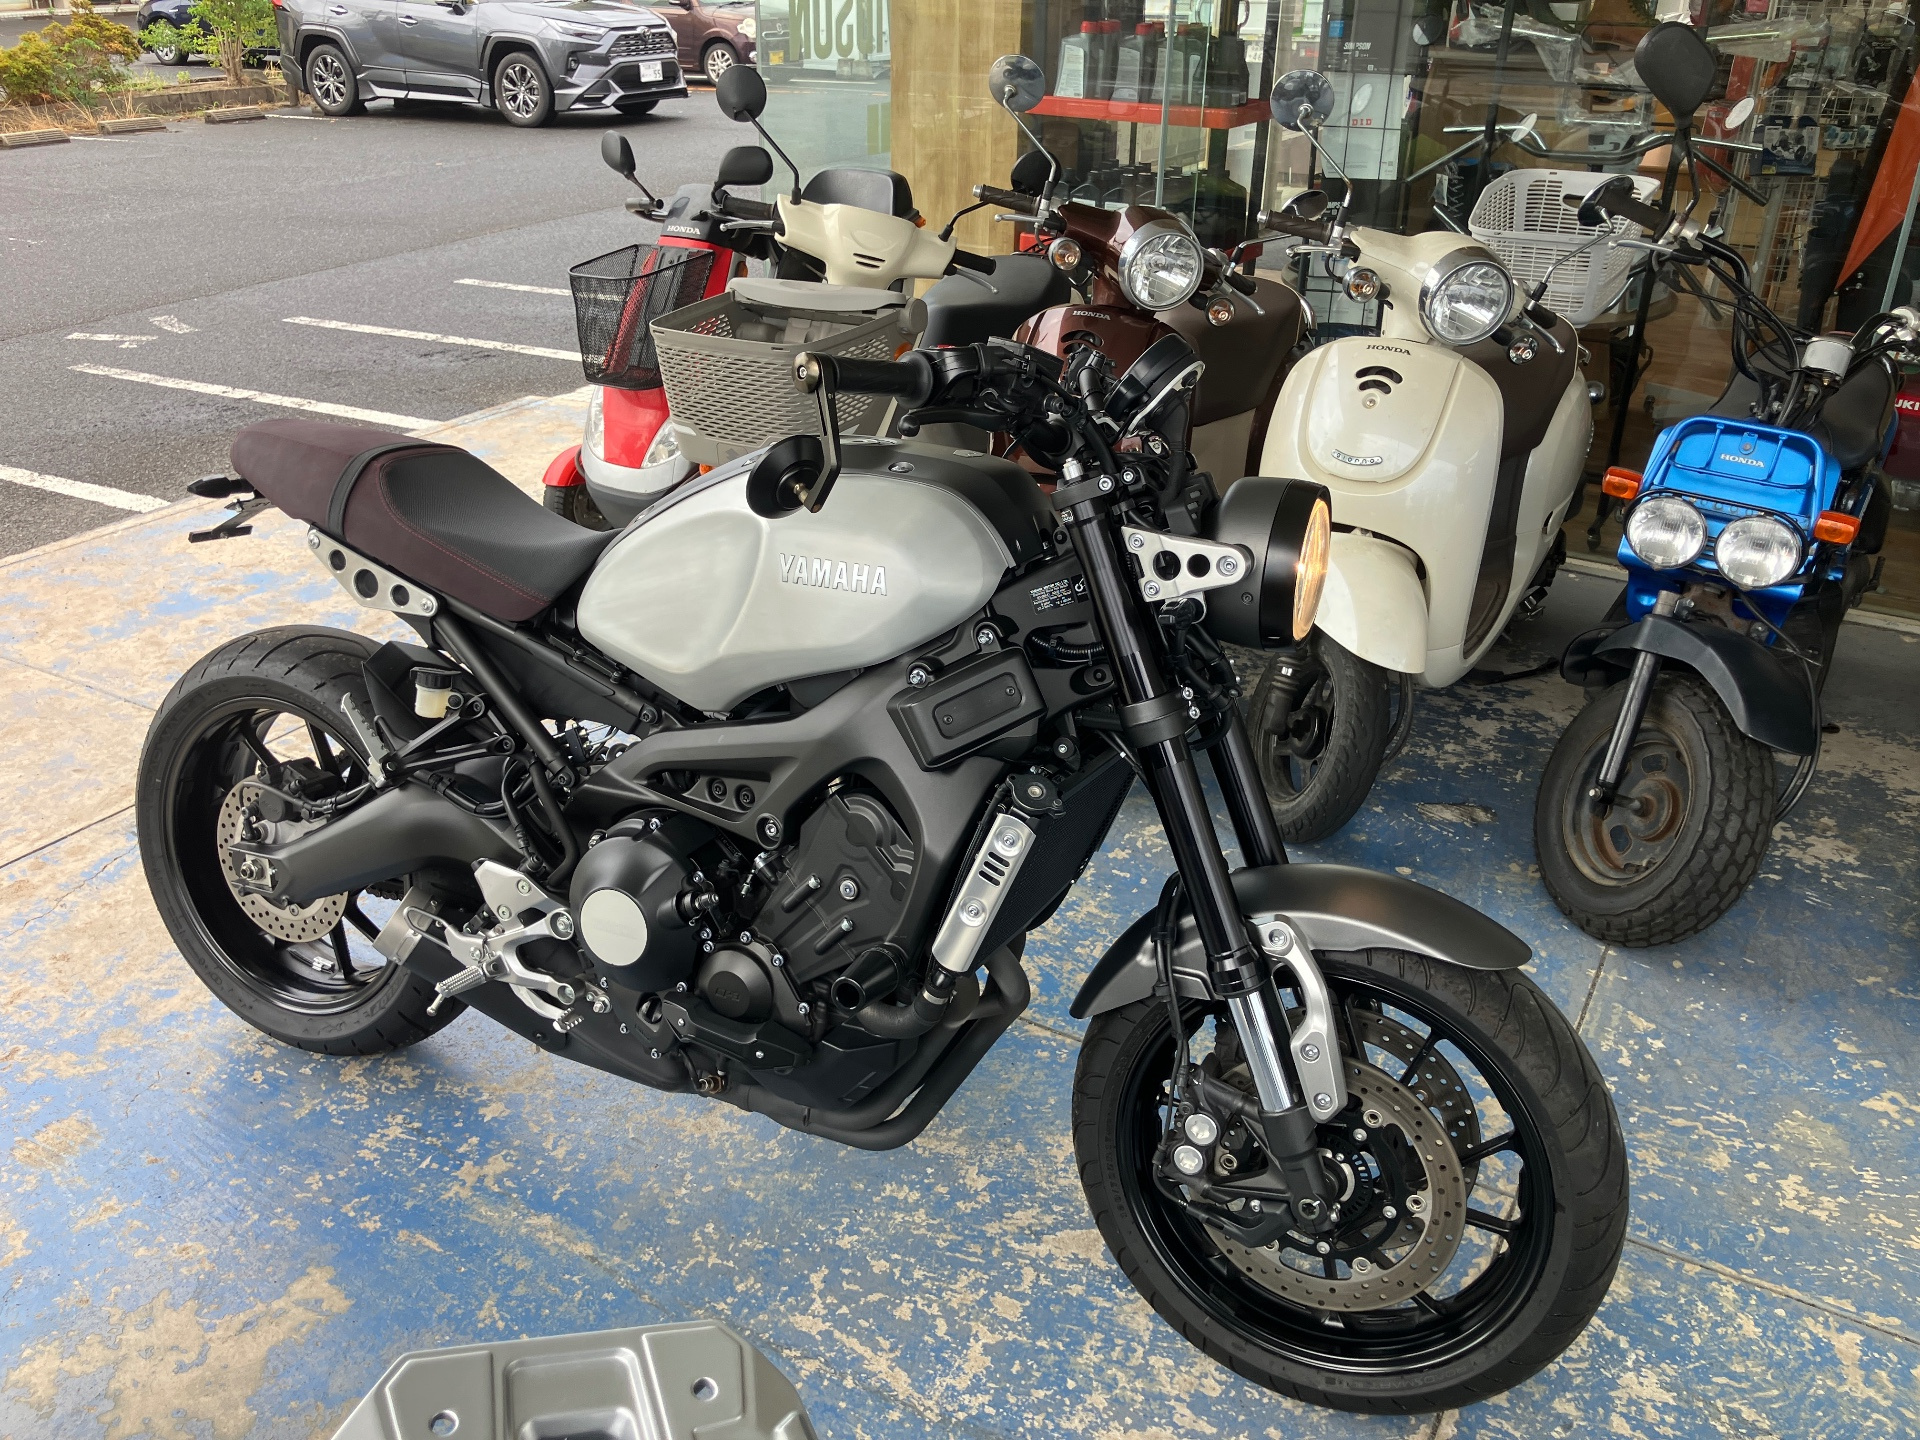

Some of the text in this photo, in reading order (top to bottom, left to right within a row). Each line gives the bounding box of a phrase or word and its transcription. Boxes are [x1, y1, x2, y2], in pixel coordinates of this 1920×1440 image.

[667, 225, 701, 235] HONDA
[1072, 310, 1111, 321] HONDA
[1366, 344, 1411, 356] HONDA
[1894, 398, 1920, 411] UKI
[1720, 453, 1765, 468] HONDA
[779, 552, 888, 597] YAMAHA
